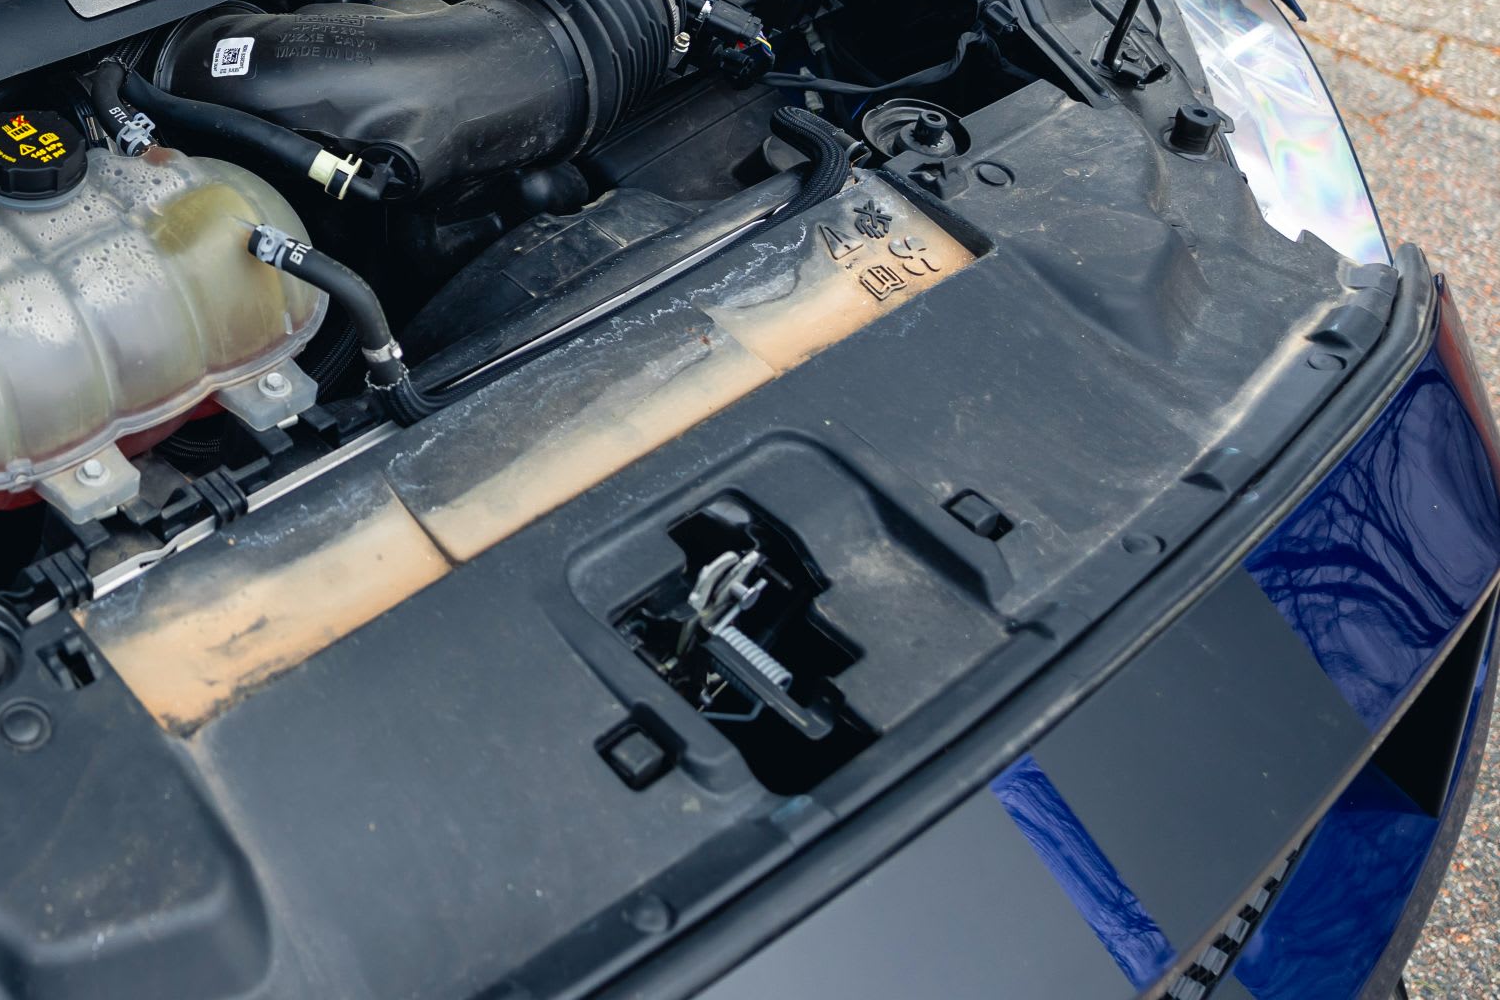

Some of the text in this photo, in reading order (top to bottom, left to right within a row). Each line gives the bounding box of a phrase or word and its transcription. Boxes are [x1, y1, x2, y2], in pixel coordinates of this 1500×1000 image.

[276, 46, 321, 58] MADE
[325, 47, 340, 59] IN
[108, 106, 128, 124] BTL
